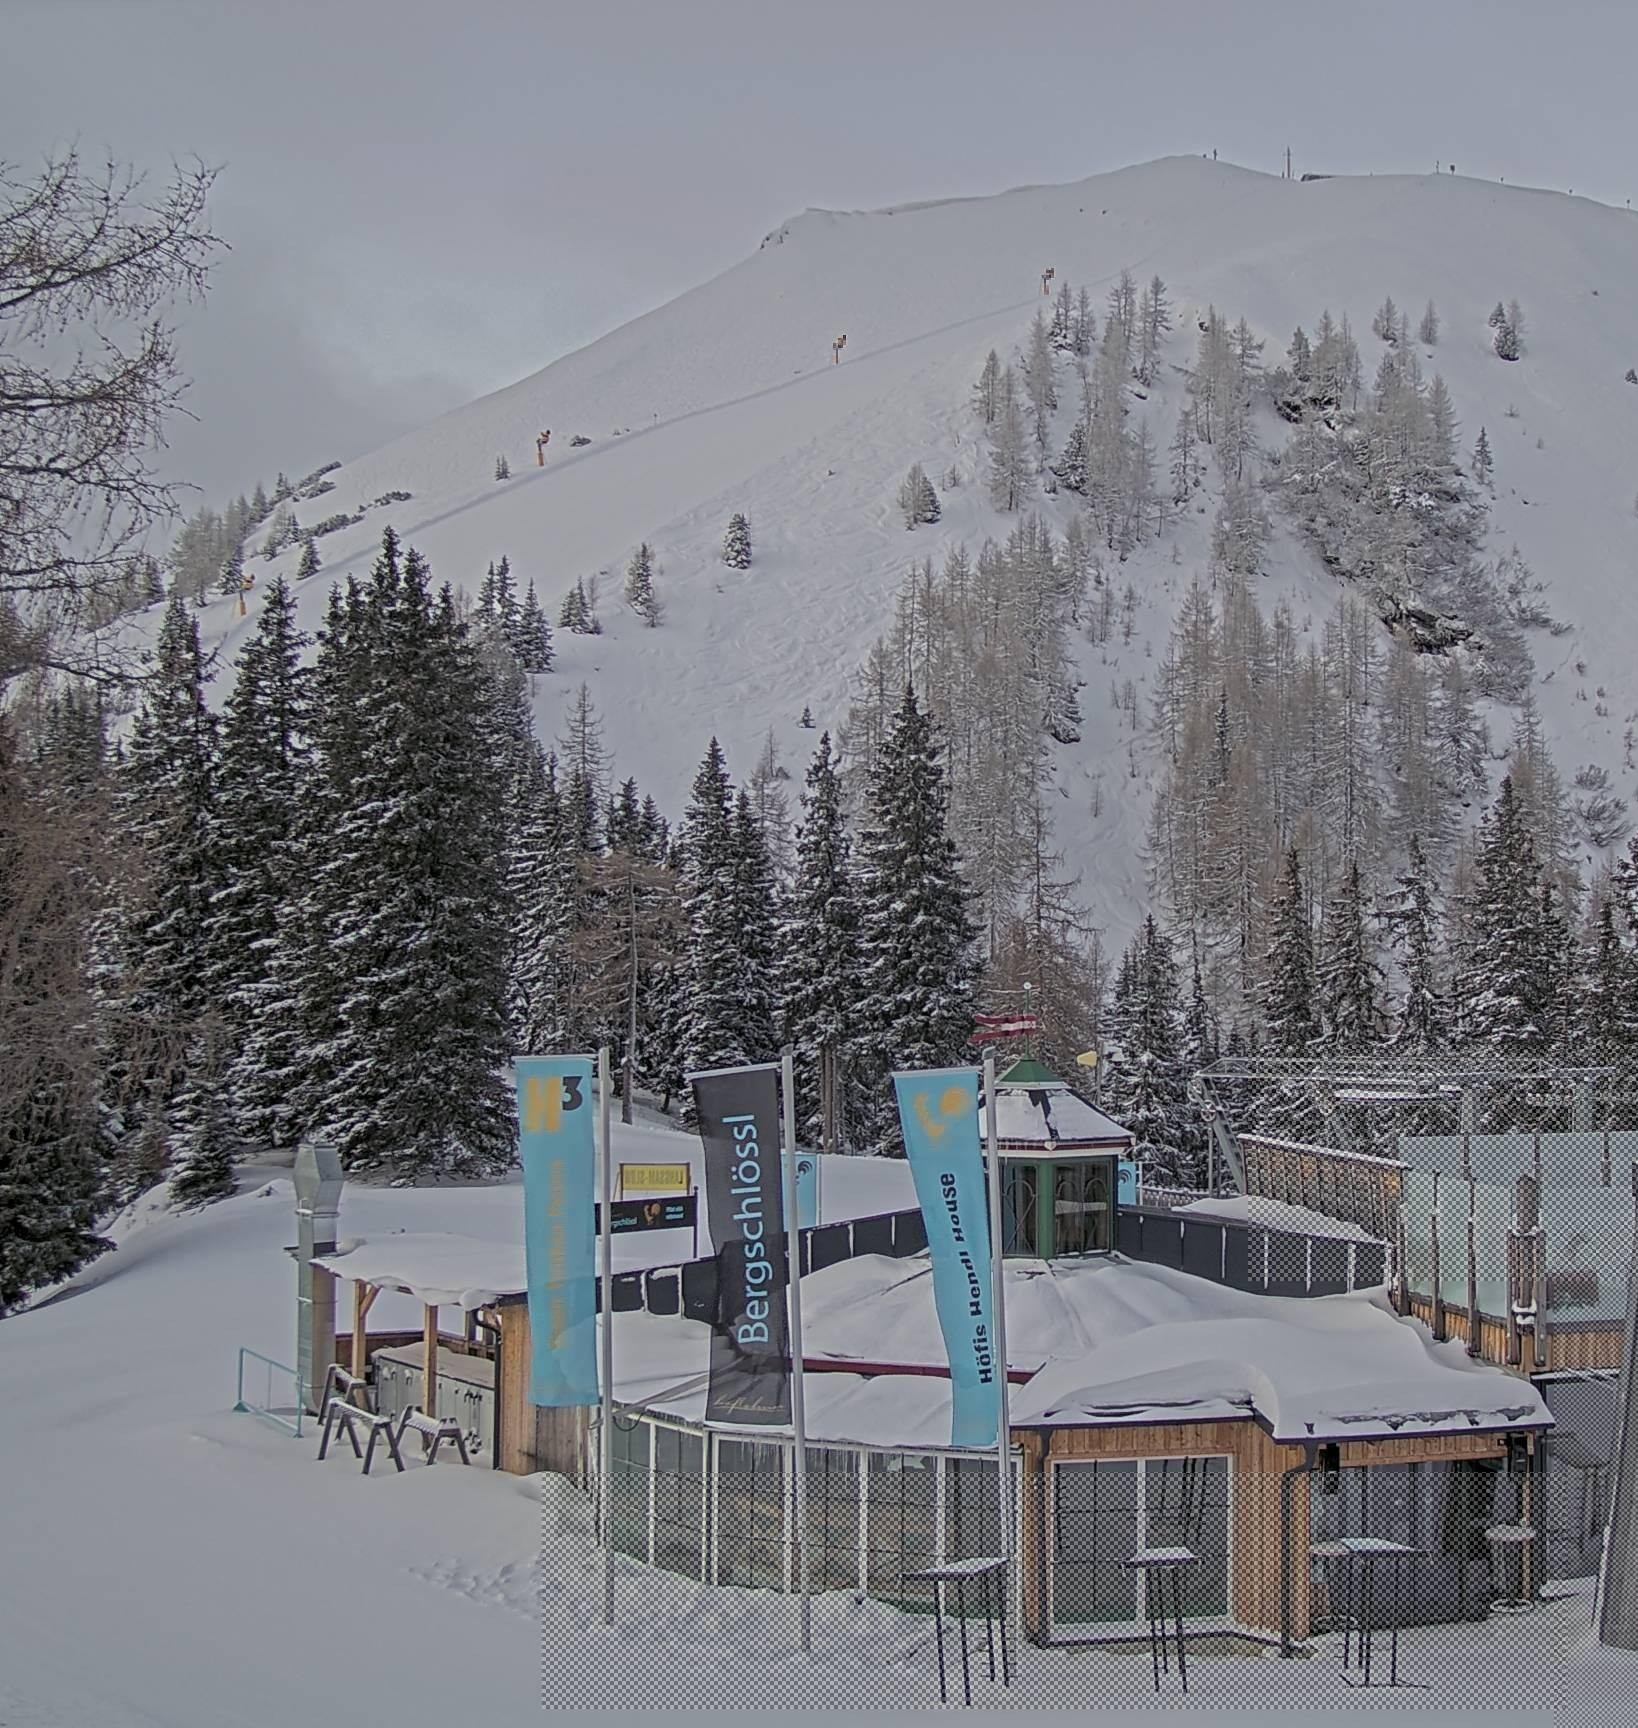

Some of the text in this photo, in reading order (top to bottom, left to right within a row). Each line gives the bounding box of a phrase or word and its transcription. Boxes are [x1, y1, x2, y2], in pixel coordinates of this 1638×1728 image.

[722, 1114, 773, 1344] Bergschlössl
[940, 1173, 993, 1384] Höfis Hendl House
